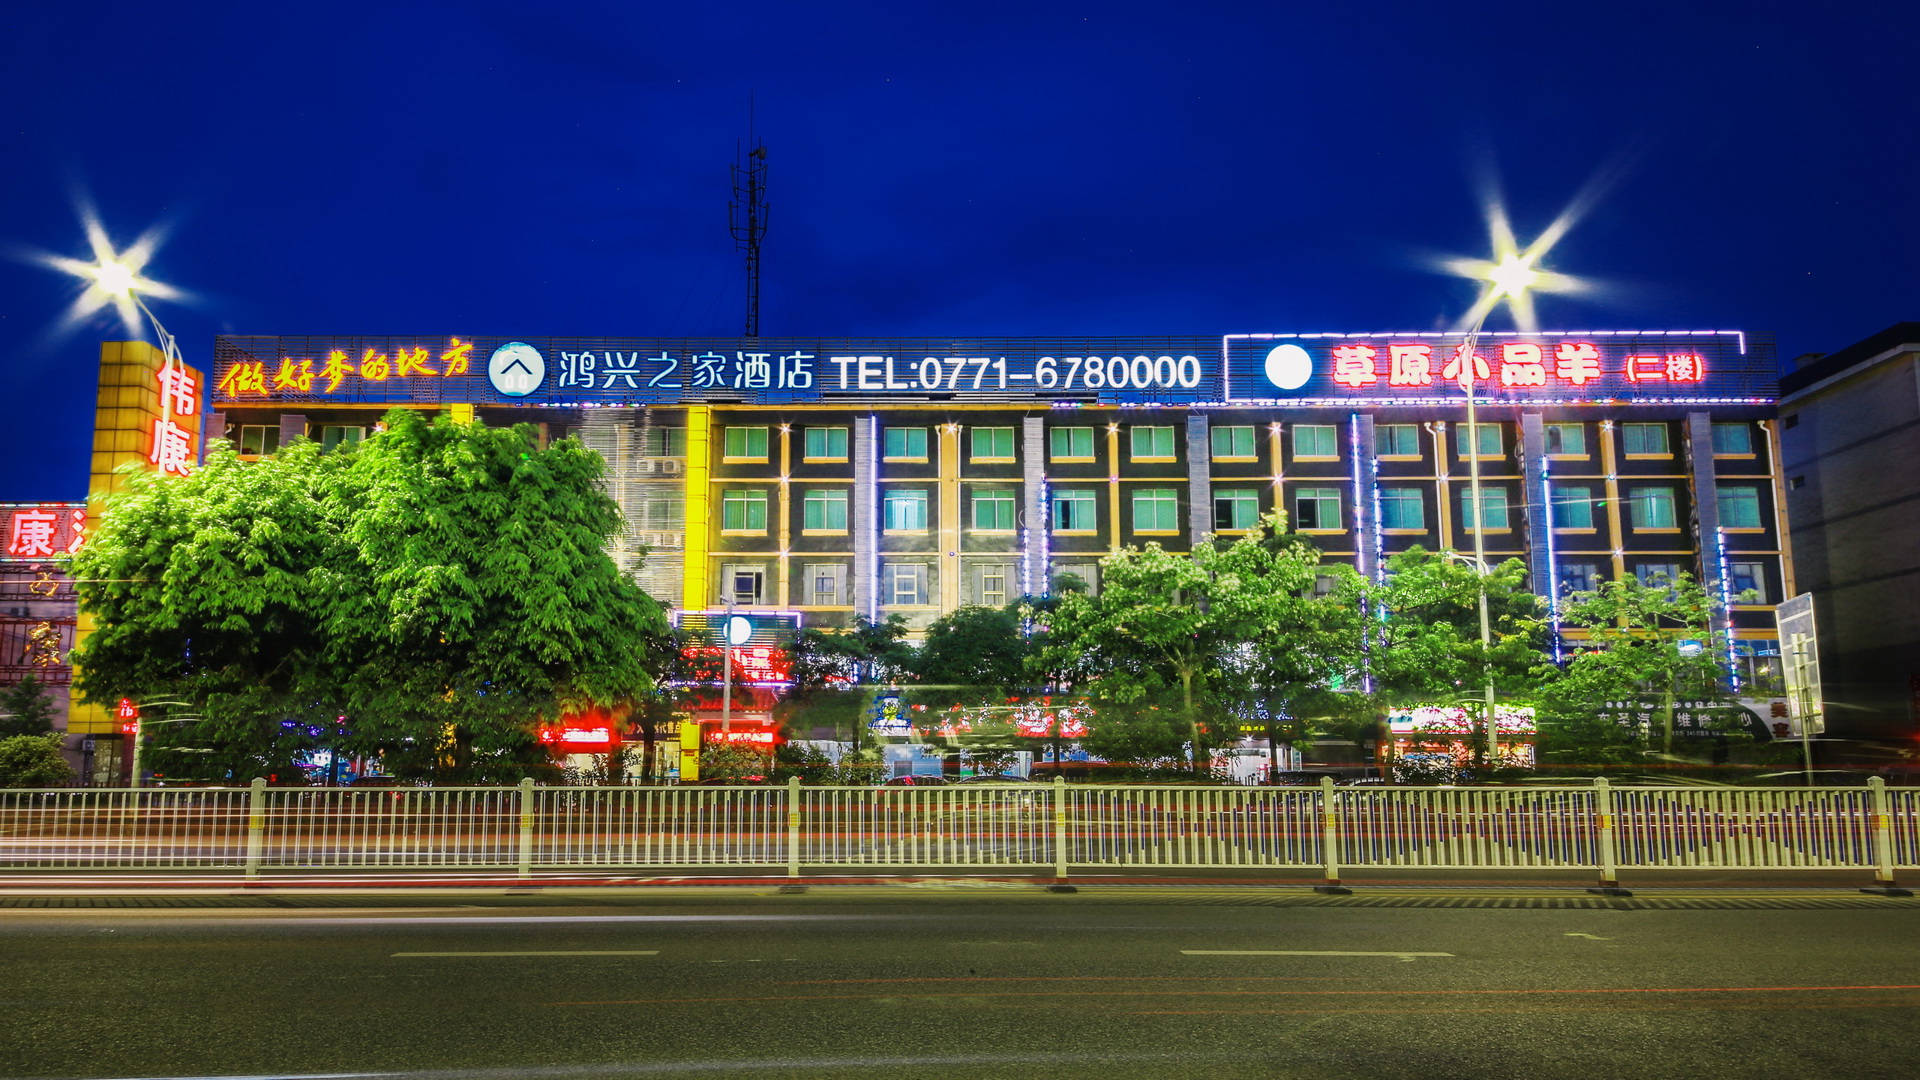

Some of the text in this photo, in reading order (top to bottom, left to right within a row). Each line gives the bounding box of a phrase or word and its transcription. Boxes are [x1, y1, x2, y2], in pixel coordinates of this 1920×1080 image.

[219, 337, 473, 397] 做好梦的地方
[559, 351, 1202, 389] 鸿兴之家酒店 TEL:0771-6780000
[1333, 343, 1601, 387] 草原小品羊
[149, 362, 196, 477] 伟康
